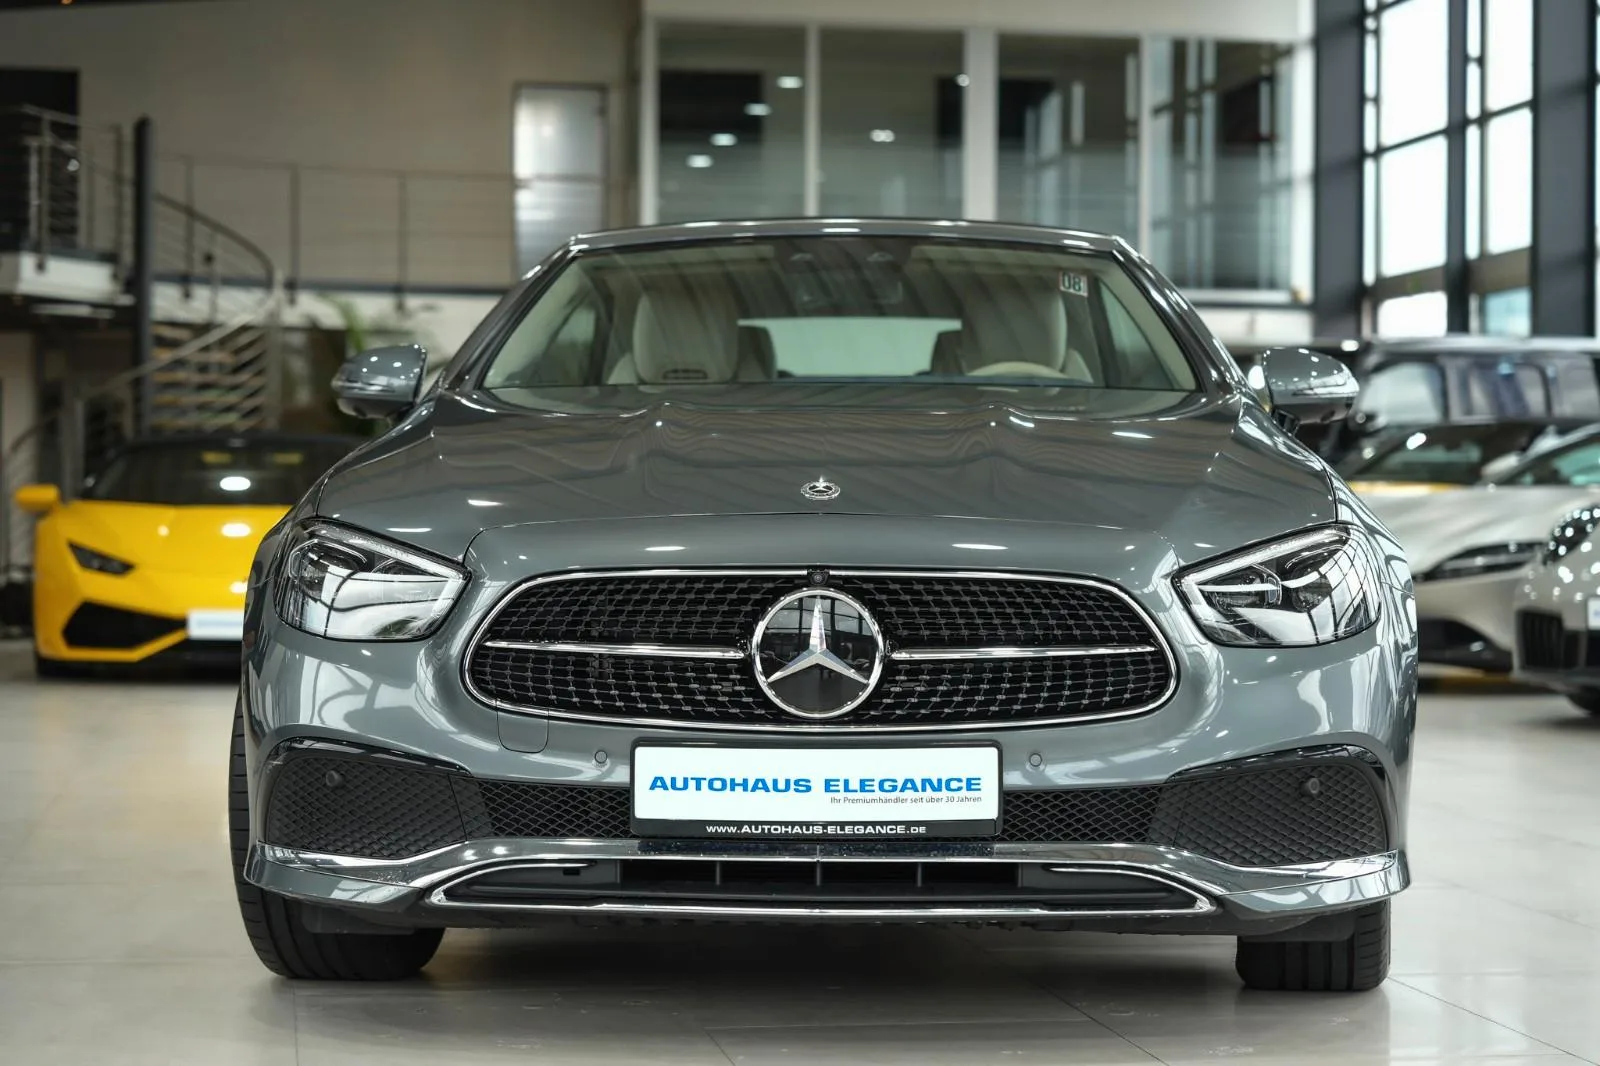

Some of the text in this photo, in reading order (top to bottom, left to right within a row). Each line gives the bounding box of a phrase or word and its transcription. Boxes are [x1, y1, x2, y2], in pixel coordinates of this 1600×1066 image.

[1062, 272, 1082, 291] 08
[649, 776, 982, 793] AUTOHAUS ELEGANCE
[830, 796, 841, 804] Ihr
[843, 796, 909, 804] Premiumhändler
[910, 796, 924, 804] seit
[925, 795, 943, 803] über
[956, 795, 982, 803] Jahren
